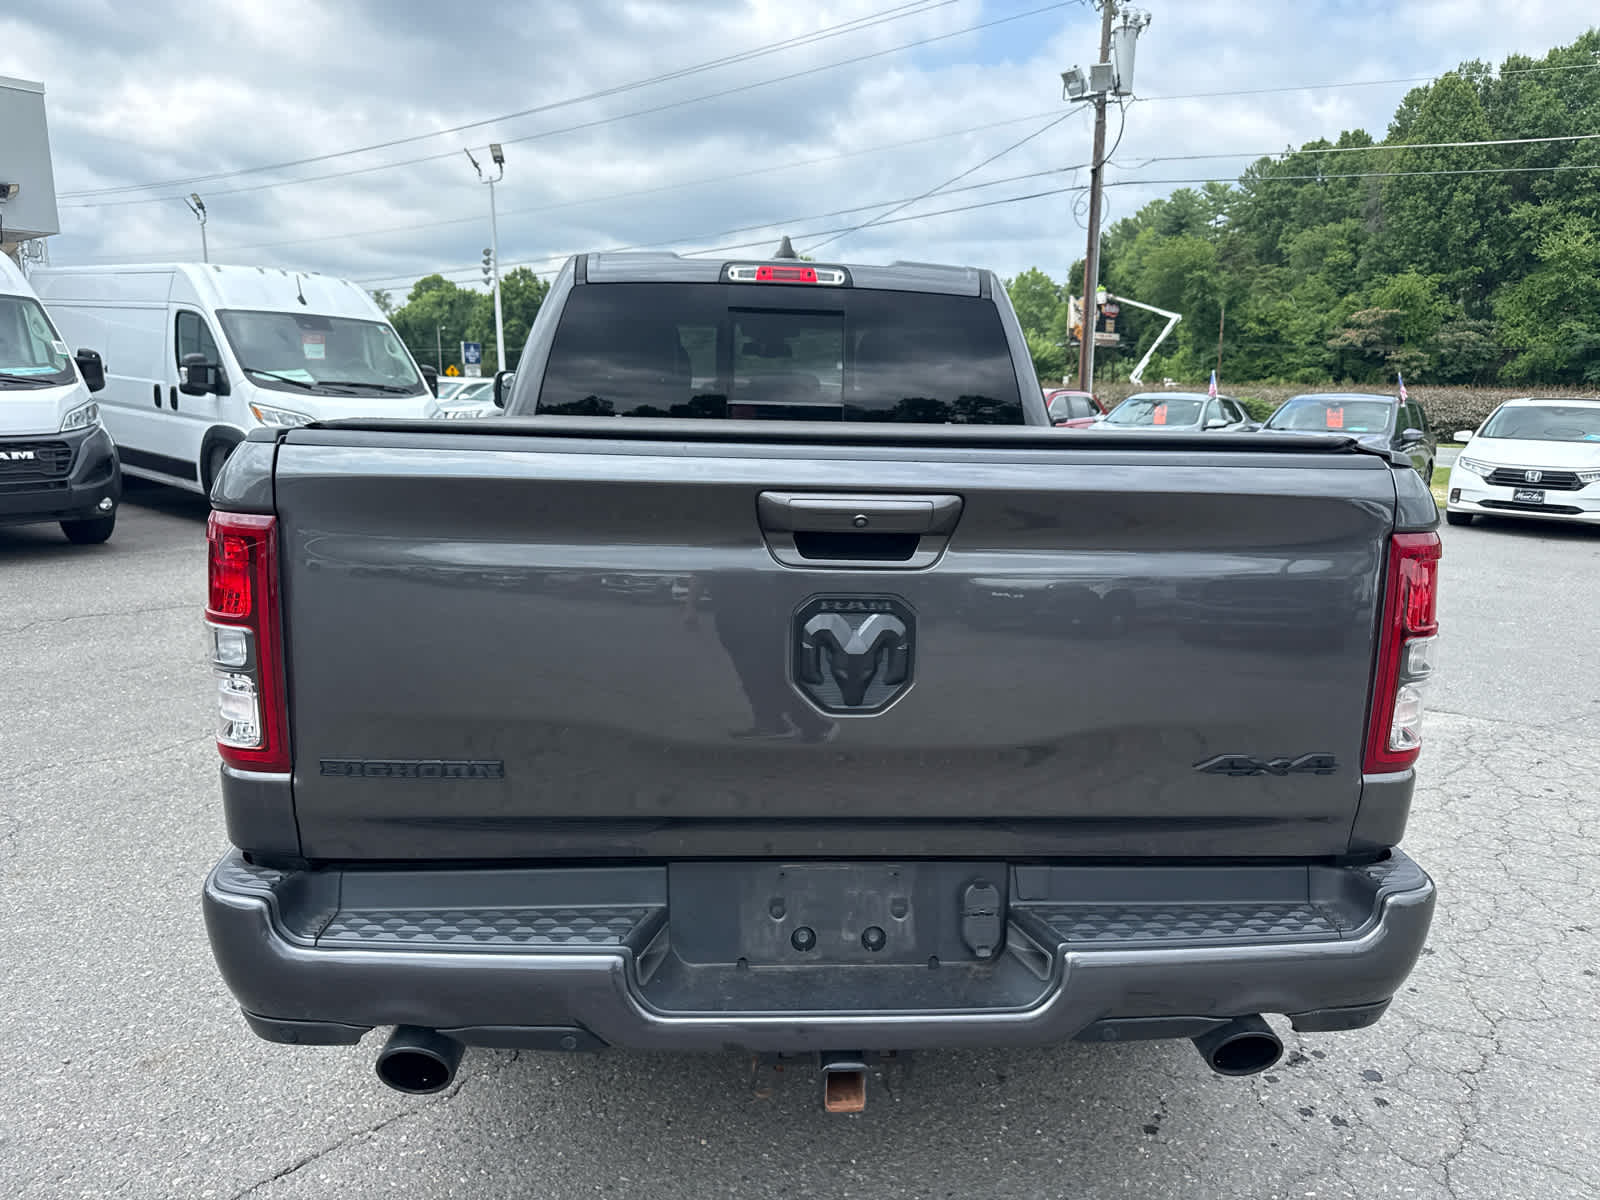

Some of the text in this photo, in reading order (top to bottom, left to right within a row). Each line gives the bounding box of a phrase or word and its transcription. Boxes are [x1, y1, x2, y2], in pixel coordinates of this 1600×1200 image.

[0, 451, 34, 460] AM
[819, 600, 892, 610] RAM
[319, 759, 505, 778] BIGHORN
